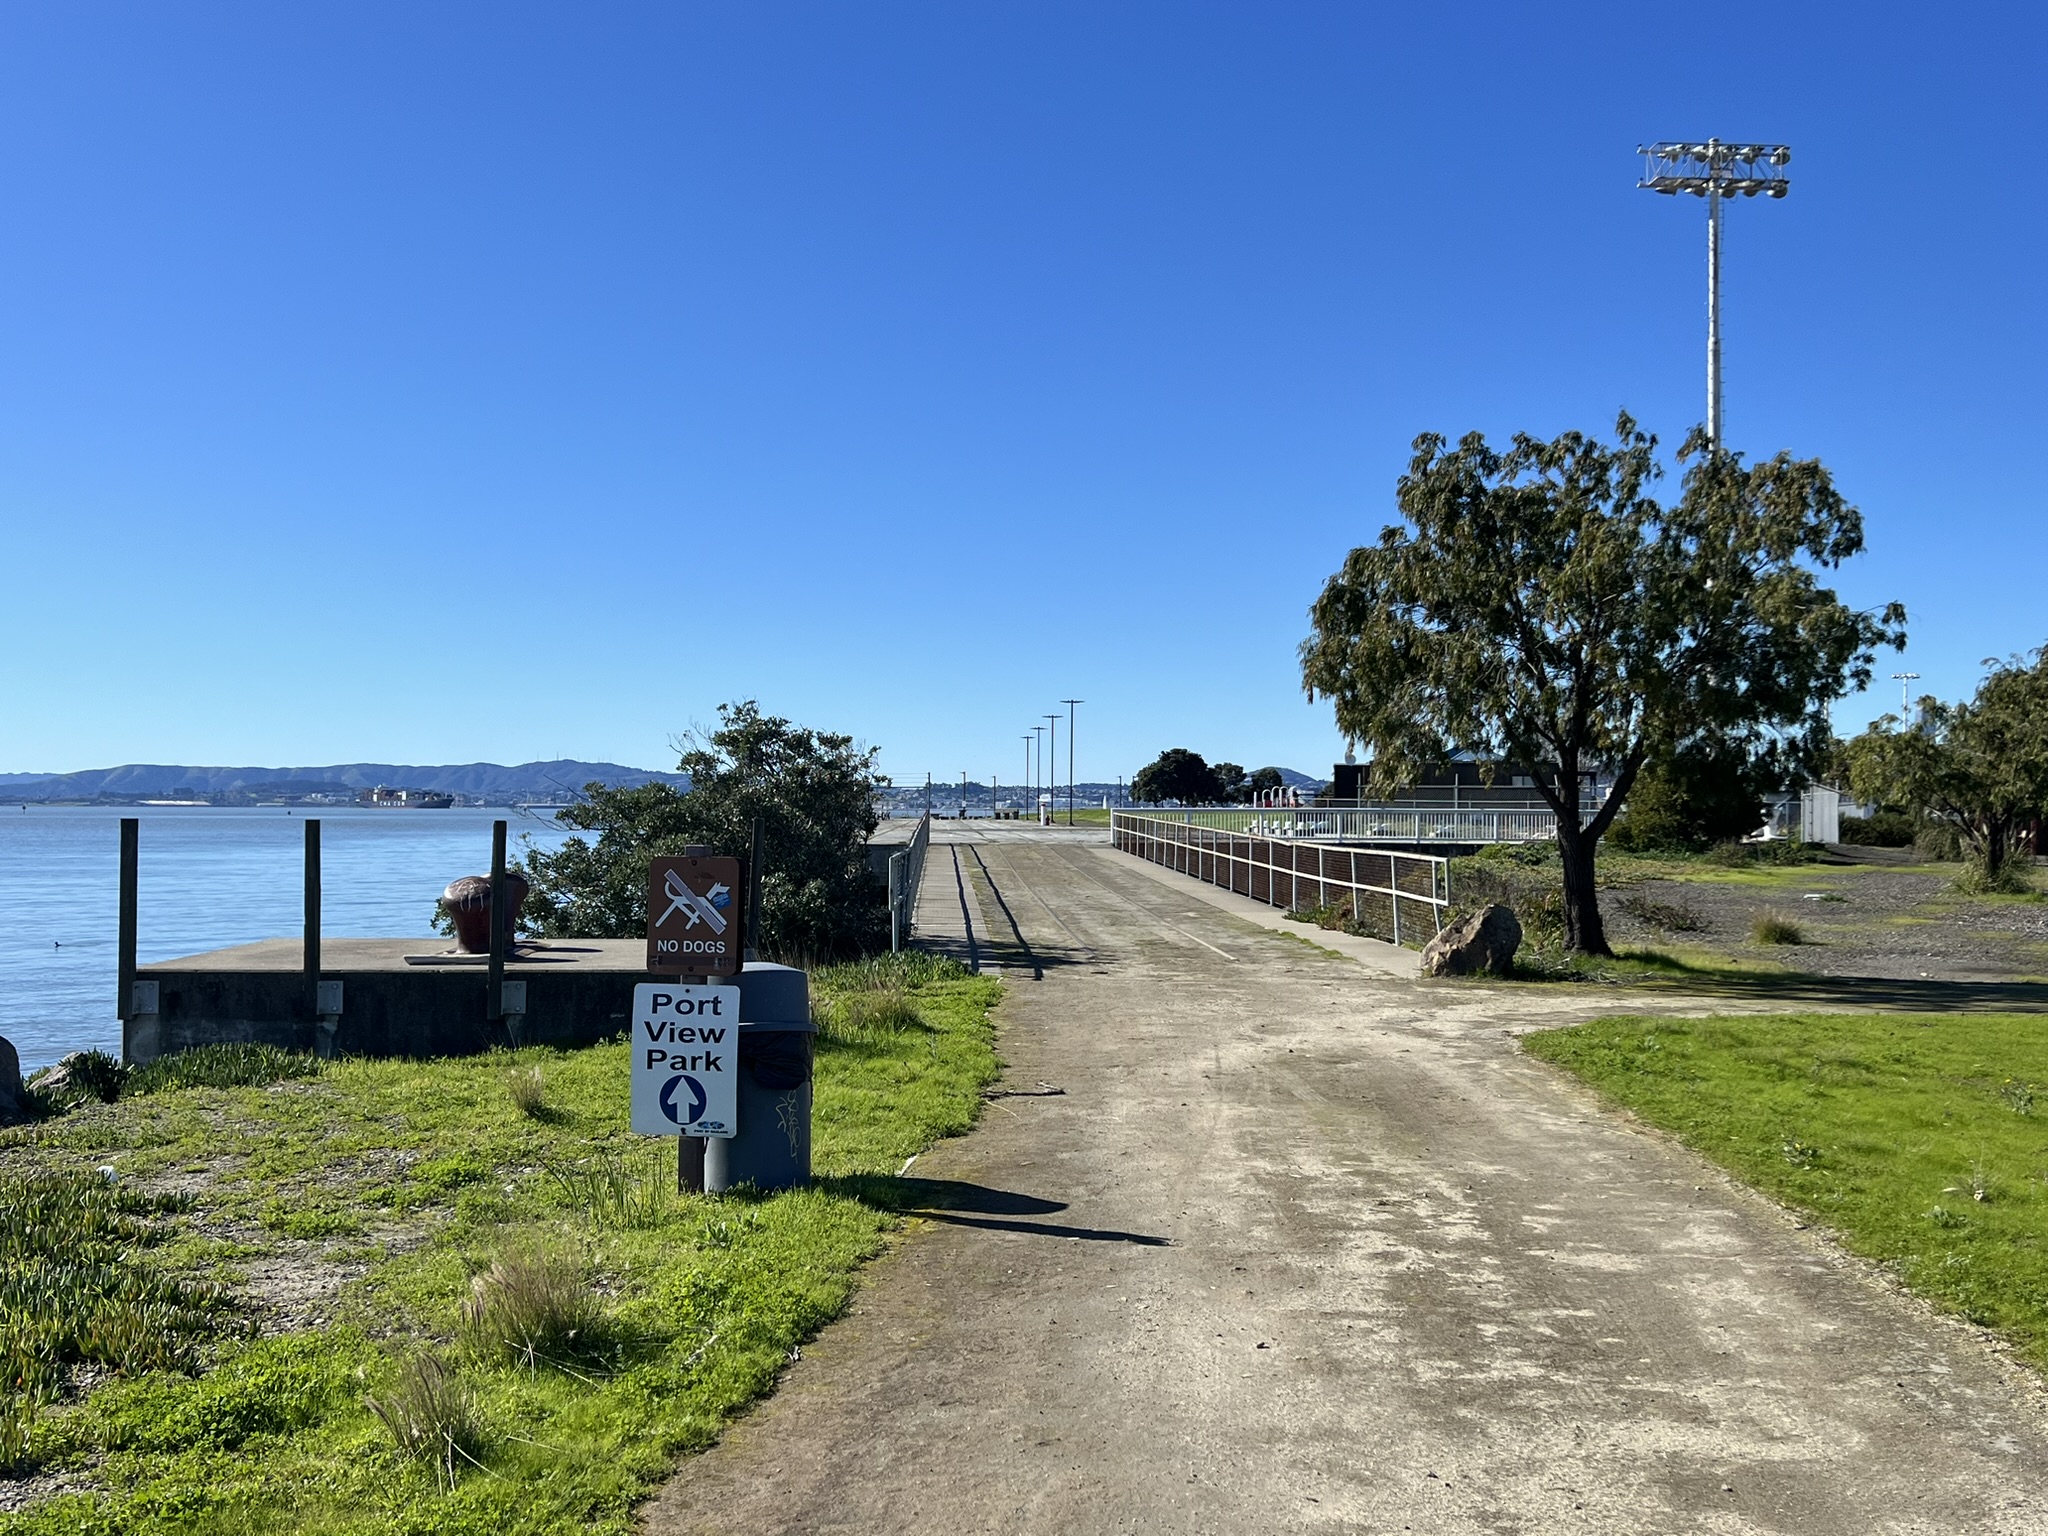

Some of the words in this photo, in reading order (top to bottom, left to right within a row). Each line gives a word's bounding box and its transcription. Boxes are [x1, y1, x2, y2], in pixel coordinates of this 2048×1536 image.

[657, 940, 679, 953] NO
[683, 940, 726, 954] DOGS
[651, 993, 722, 1015] Port
[644, 1021, 726, 1043] View
[646, 1049, 723, 1072] Park
